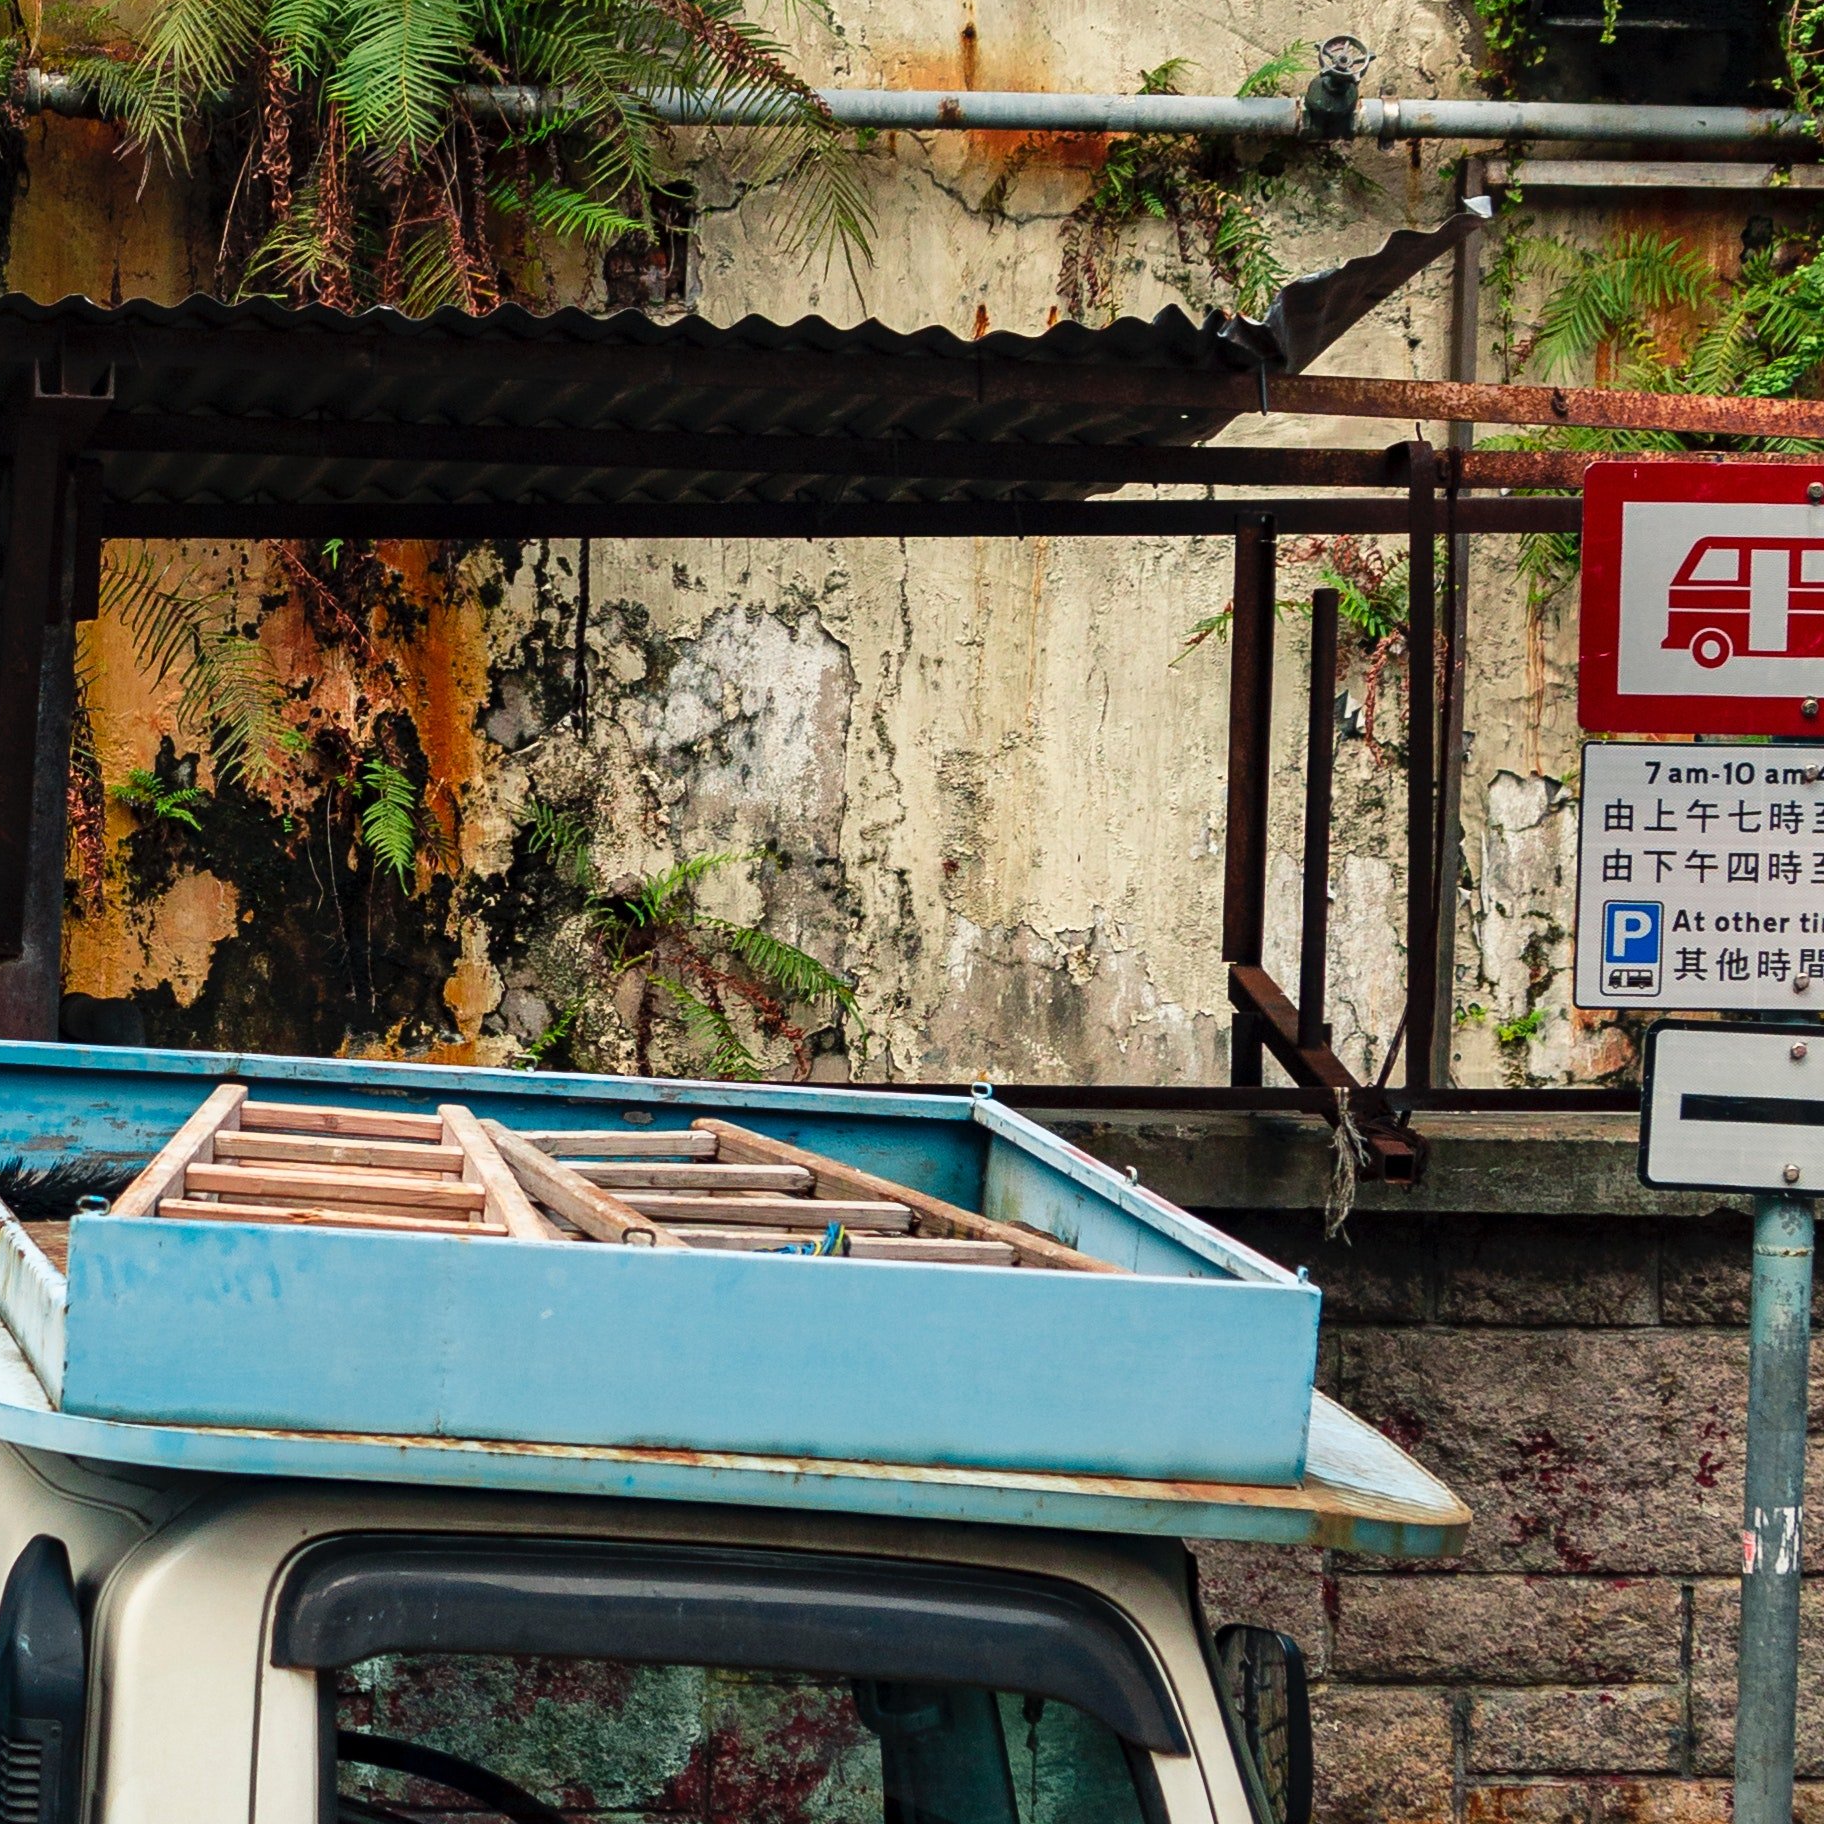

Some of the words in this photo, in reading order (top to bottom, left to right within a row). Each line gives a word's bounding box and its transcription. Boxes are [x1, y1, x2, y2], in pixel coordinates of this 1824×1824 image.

[1644, 760, 1662, 785] 7
[1612, 909, 1653, 958] P
[1671, 908, 1706, 933] At
[1714, 910, 1791, 934] other
[1799, 912, 1824, 934] ti
